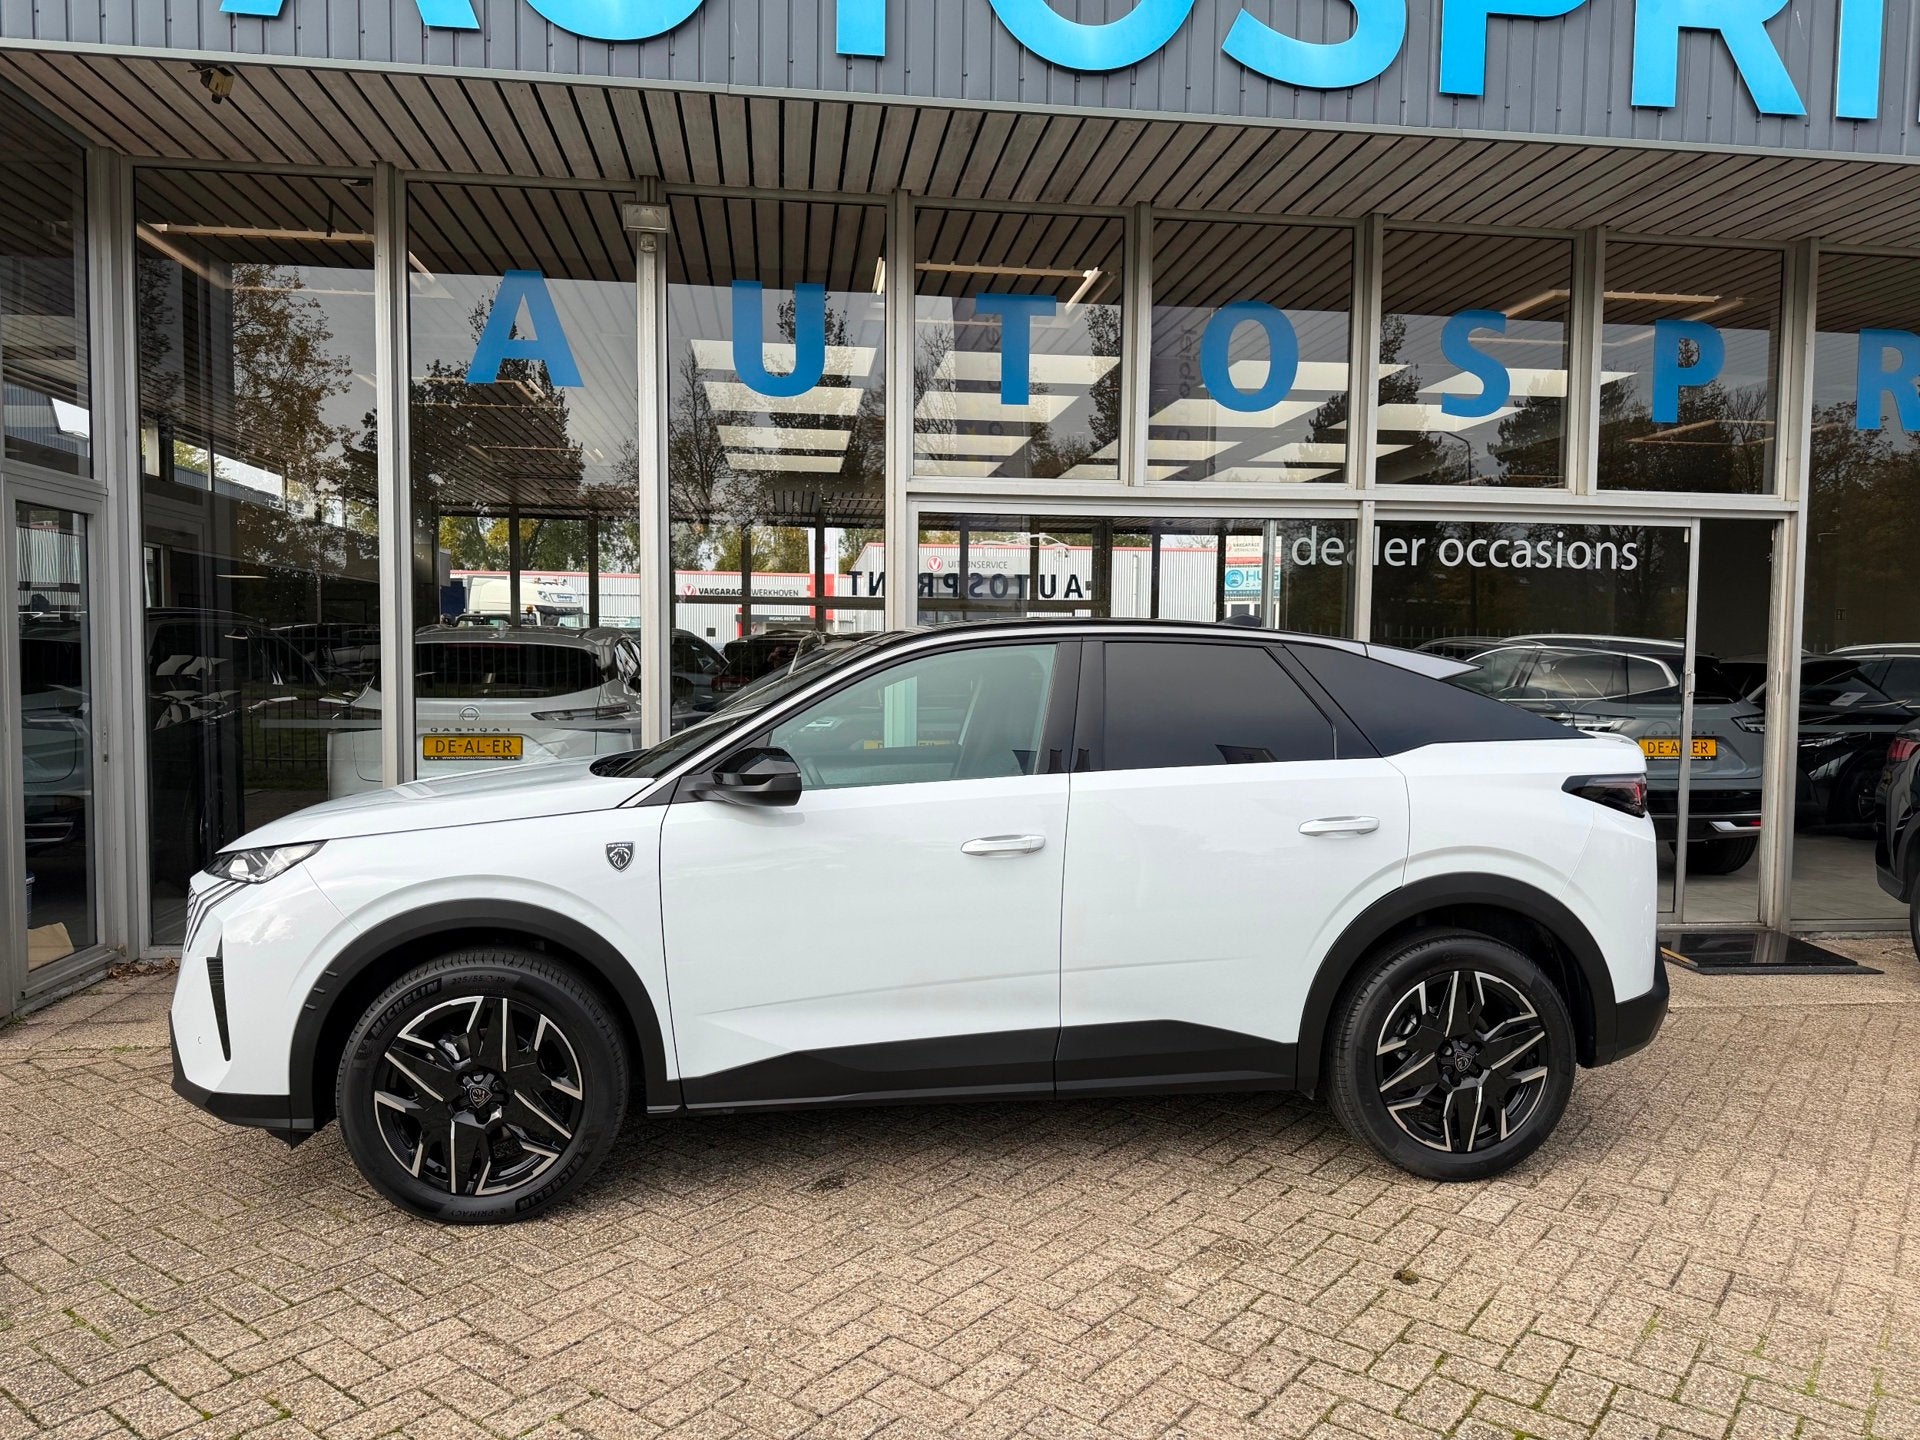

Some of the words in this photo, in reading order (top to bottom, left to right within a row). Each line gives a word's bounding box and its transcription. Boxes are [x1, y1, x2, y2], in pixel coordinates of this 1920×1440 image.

[1292, 526, 1425, 567] deler
[1438, 531, 1638, 571] occasions
[698, 587, 743, 596] VAKGARAG
[751, 588, 799, 597] WERKHOVEN
[435, 739, 512, 754] DE-AL-ER
[370, 980, 439, 1038] MICHELIN
